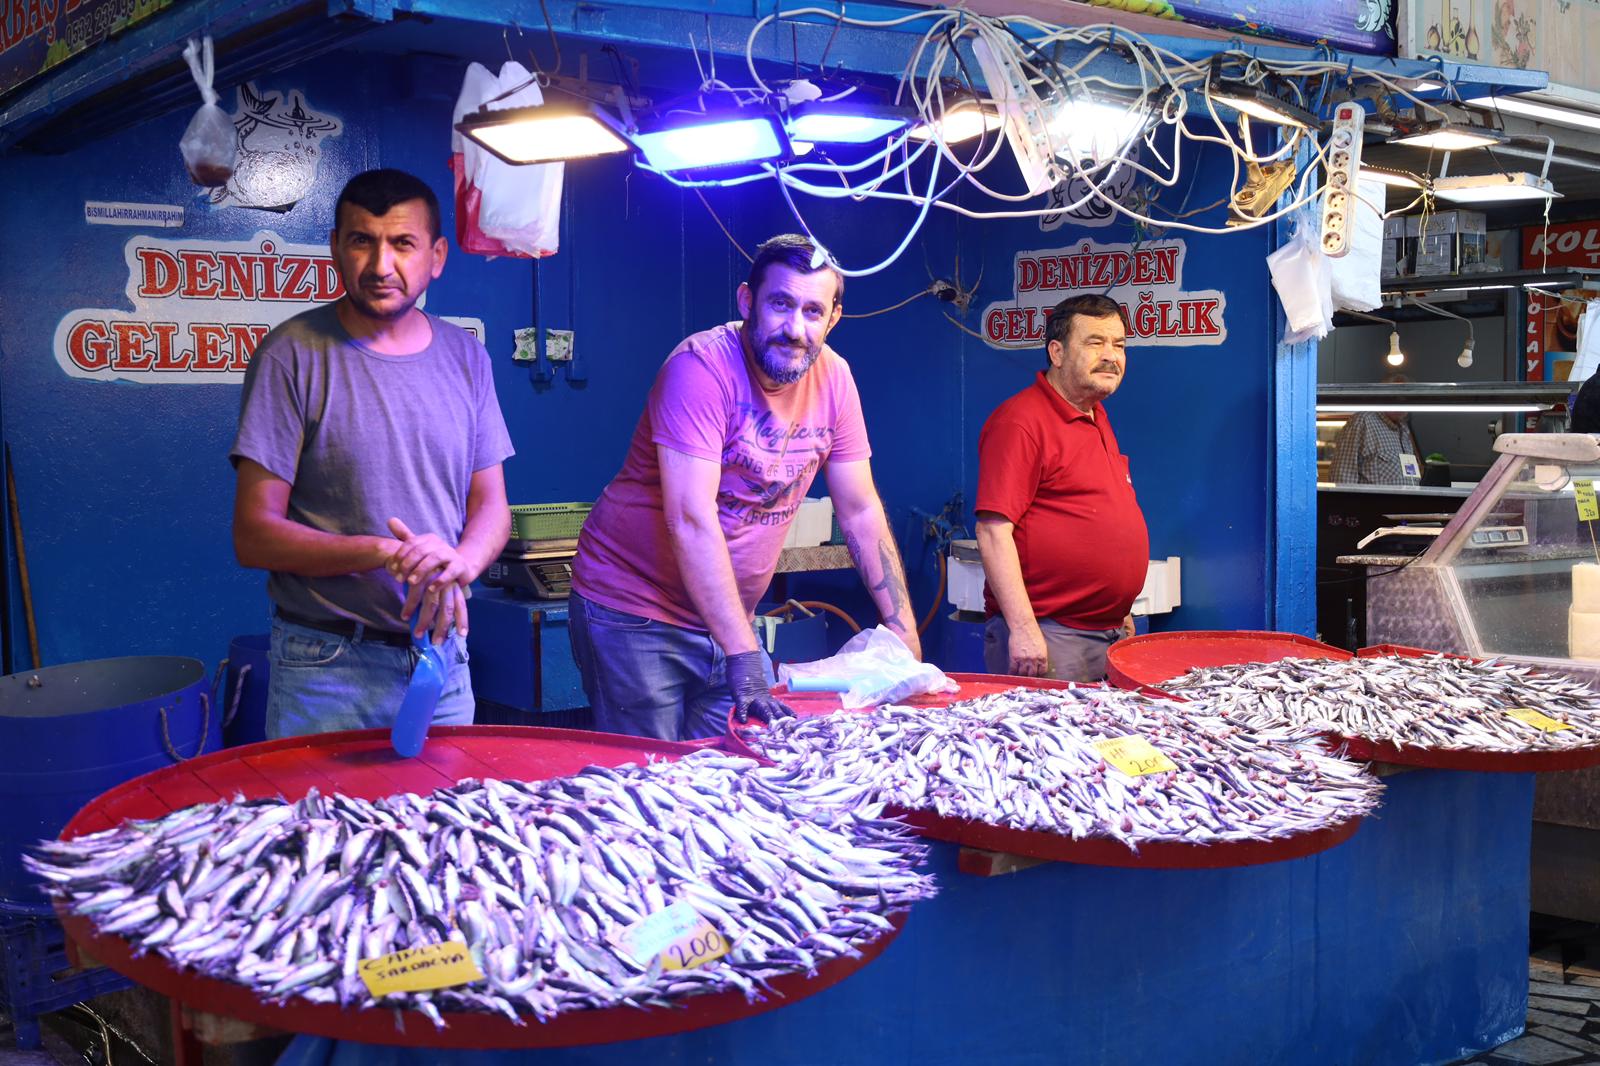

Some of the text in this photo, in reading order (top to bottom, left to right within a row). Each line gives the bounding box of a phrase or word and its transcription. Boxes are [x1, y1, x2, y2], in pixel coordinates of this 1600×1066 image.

[136, 240, 347, 301] DENİZD
[1018, 243, 1180, 292] DENİZDEN
[668, 930, 721, 968] 200
